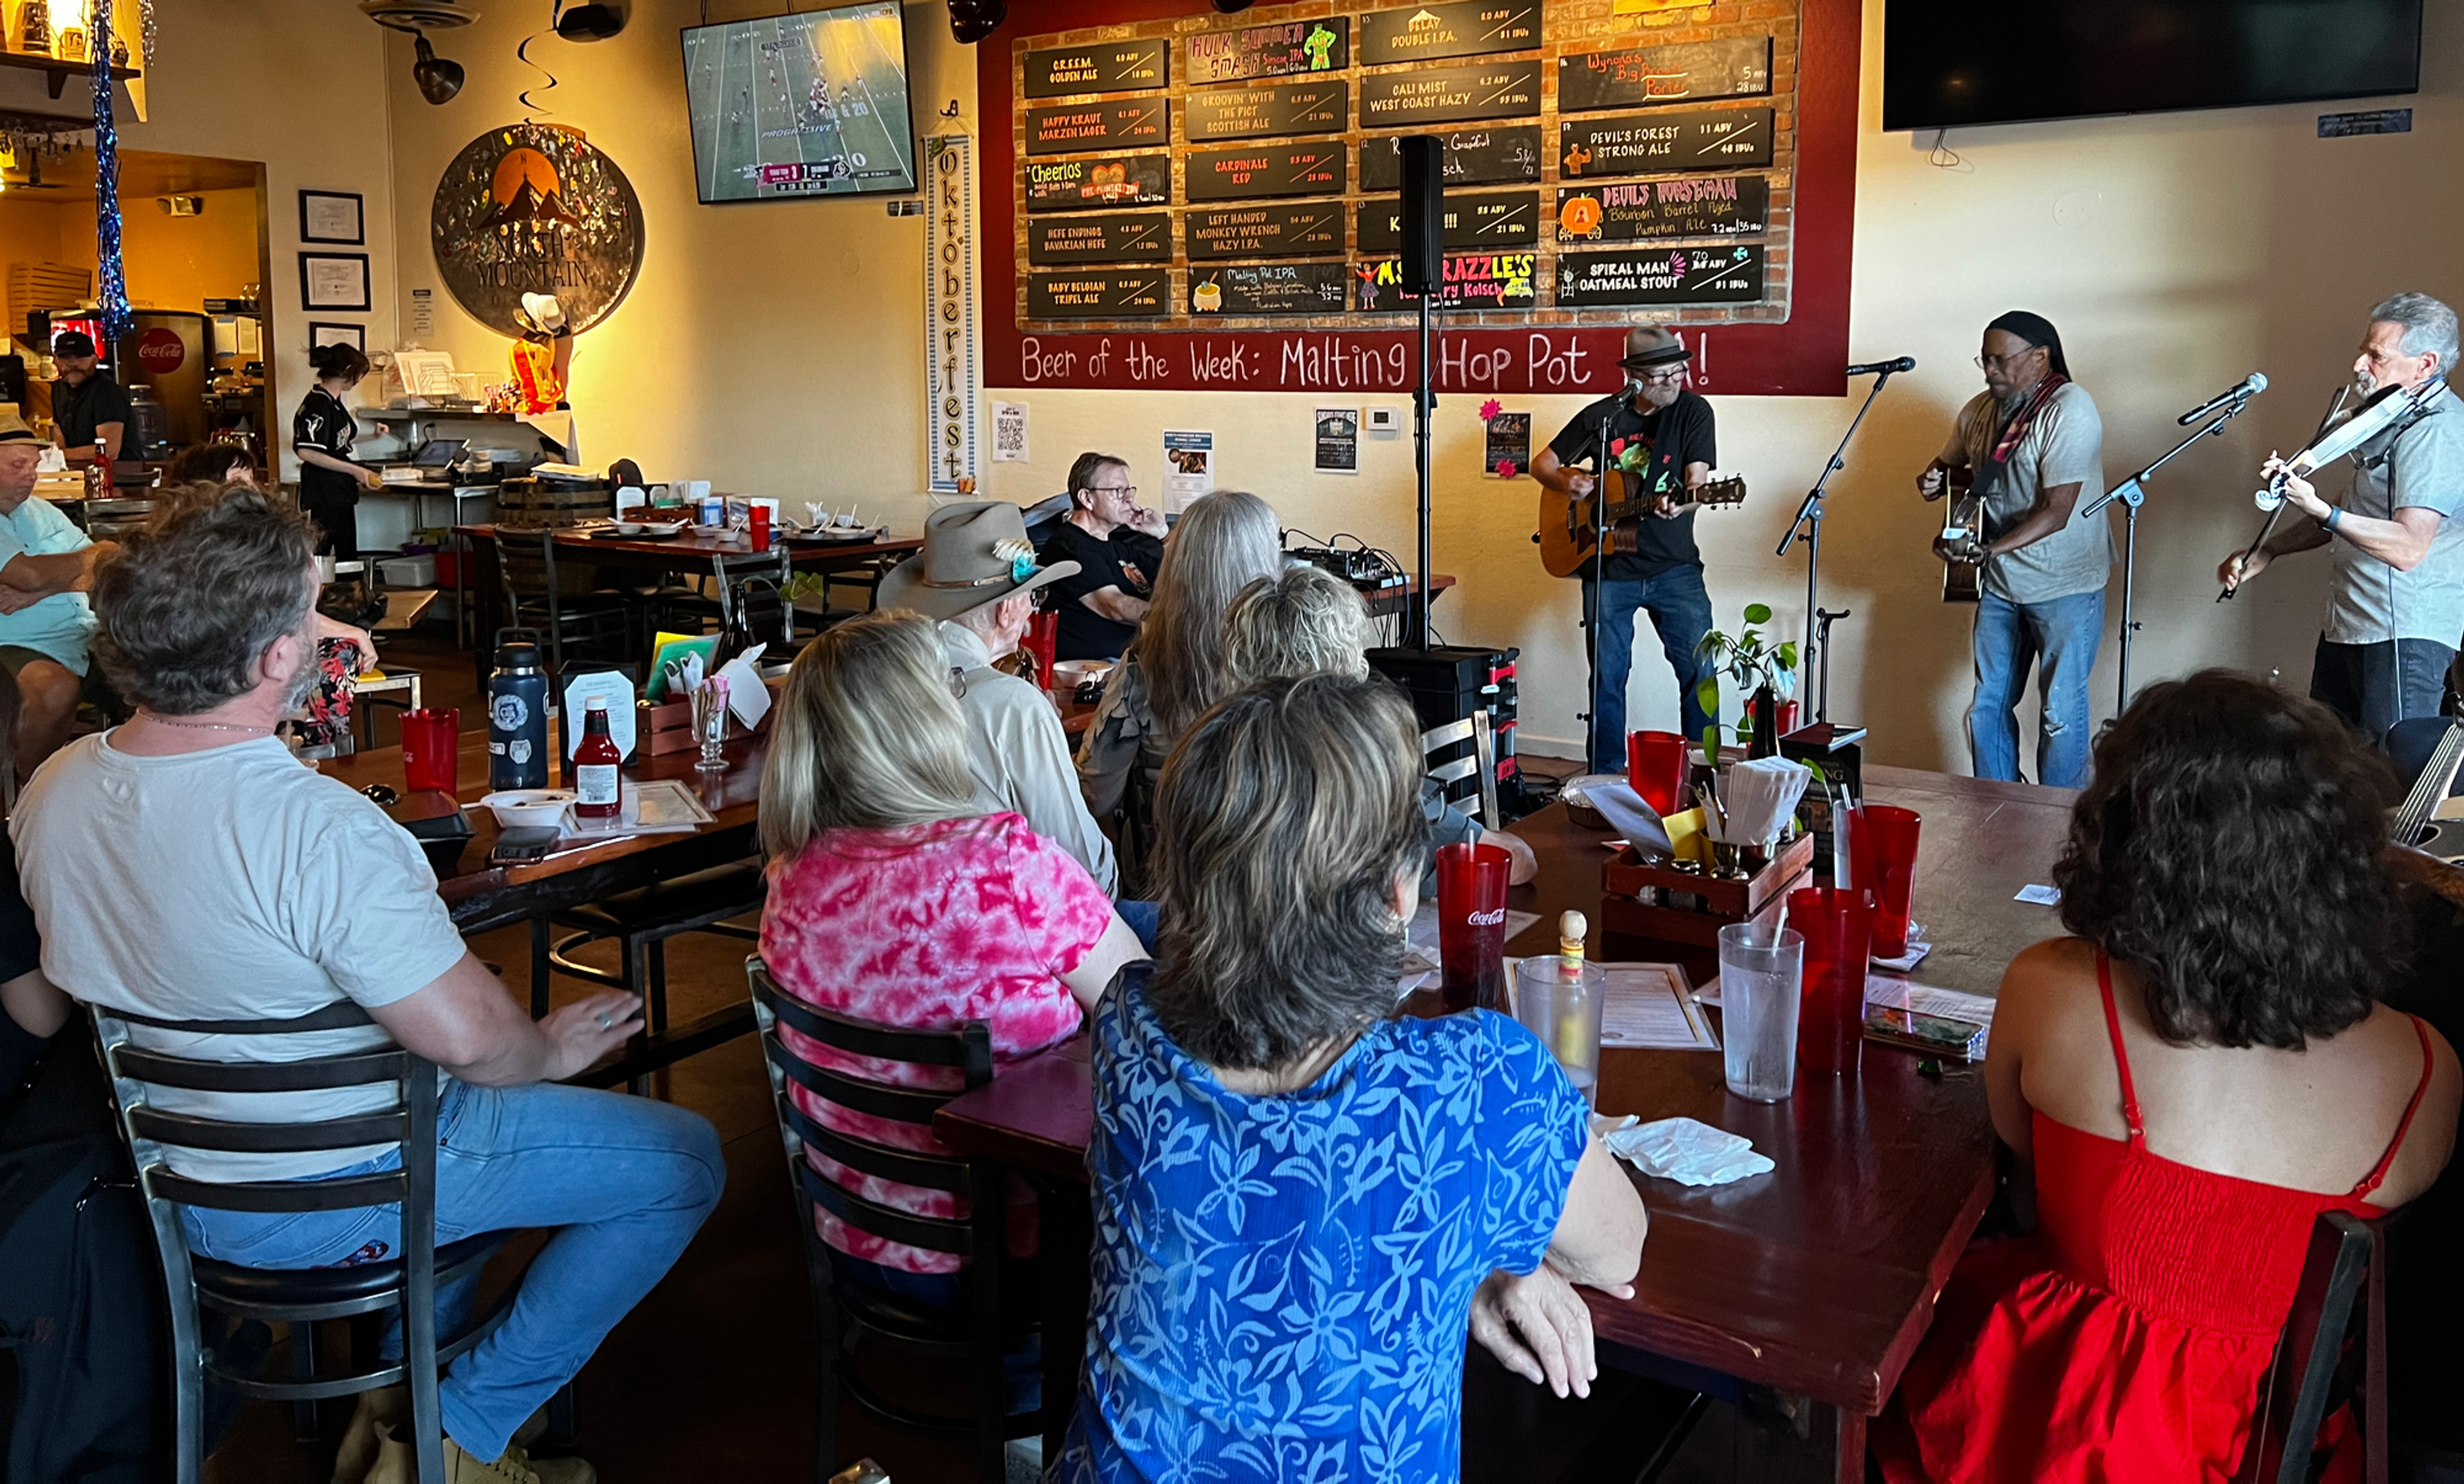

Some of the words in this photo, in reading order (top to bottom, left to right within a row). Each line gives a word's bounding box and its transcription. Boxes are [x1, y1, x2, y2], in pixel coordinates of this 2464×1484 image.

[1409, 17, 1442, 32] BELAY
[1192, 32, 1233, 58] HULK
[1392, 33, 1430, 49] DOUBLE
[1289, 48, 1304, 62] IPA
[1050, 70, 1080, 83] GOLDEN
[1082, 69, 1098, 81] ALE
[1616, 65, 1638, 82] Big
[1393, 83, 1415, 96] CALI
[1418, 81, 1447, 95] MIST
[1646, 78, 1687, 95] Porter
[1202, 93, 1247, 107] GROOVIN'
[1248, 91, 1275, 103] WITH
[1370, 98, 1399, 112] WEST
[1402, 95, 1436, 109] COAST
[1439, 92, 1472, 106] HAZY
[852, 102, 869, 117] 20
[1219, 108, 1235, 119] THE
[1238, 106, 1258, 117] PICT
[1043, 115, 1069, 128] HAPPY
[1071, 113, 1101, 125] KRAUT
[1207, 120, 1249, 133] SCOTTISH
[1252, 118, 1270, 129] ALE
[1714, 123, 1733, 133] ABV
[1039, 128, 1077, 141] MARZEN
[1079, 125, 1107, 137] LAGER
[1591, 130, 1631, 144] DEVIL'S
[1635, 126, 1680, 141] FOREST
[1451, 133, 1491, 151] Grapefruit
[1598, 144, 1645, 158] STRONG
[1648, 142, 1671, 156] ALE
[1032, 163, 1082, 183] Cheerios
[1233, 172, 1251, 185] RED
[1657, 178, 1737, 204] HORSEMAN
[1208, 214, 1229, 226] LEFT
[1230, 212, 1267, 224] HANDED
[1609, 208, 1656, 221] Bourbon
[1664, 202, 1699, 217] Barrel
[1709, 201, 1733, 215] Aged
[1047, 228, 1066, 239] HEFE
[1068, 227, 1102, 238] ENDINGS
[1196, 227, 1238, 239] MONKEY
[1239, 224, 1281, 236] WRENCH
[1636, 222, 1676, 237] Pumpkin
[1686, 219, 1707, 232] Ale
[1044, 239, 1085, 251] BAVARIAN
[1087, 238, 1106, 249] HEFE
[1213, 239, 1239, 251] HAZY
[1443, 254, 1535, 282] RAZZLE'S
[1590, 262, 1633, 277] SPIRAL
[1637, 261, 1670, 275] MAN
[1709, 259, 1727, 269] ABV
[477, 261, 588, 288] MOUNTAIN
[1275, 267, 1297, 279] IPA
[1048, 282, 1070, 293] BABY
[1071, 280, 1106, 292] BELGIAN
[1464, 282, 1503, 298] Kolsch
[1579, 277, 1638, 291] OATMEAL
[1641, 276, 1680, 290] STOUT
[1055, 294, 1082, 305] TRIPEL
[1084, 293, 1099, 304] ALE
[939, 148, 962, 480] Oktoberfest
[139, 343, 182, 359] Coca-Cola
[1022, 337, 1077, 382] Beer
[1089, 338, 1111, 378] of
[1125, 340, 1170, 381] the
[1190, 339, 1261, 383] Week:
[1281, 336, 1405, 387] Malting
[1441, 337, 1511, 390] Hop
[1529, 333, 1592, 387] Pot
